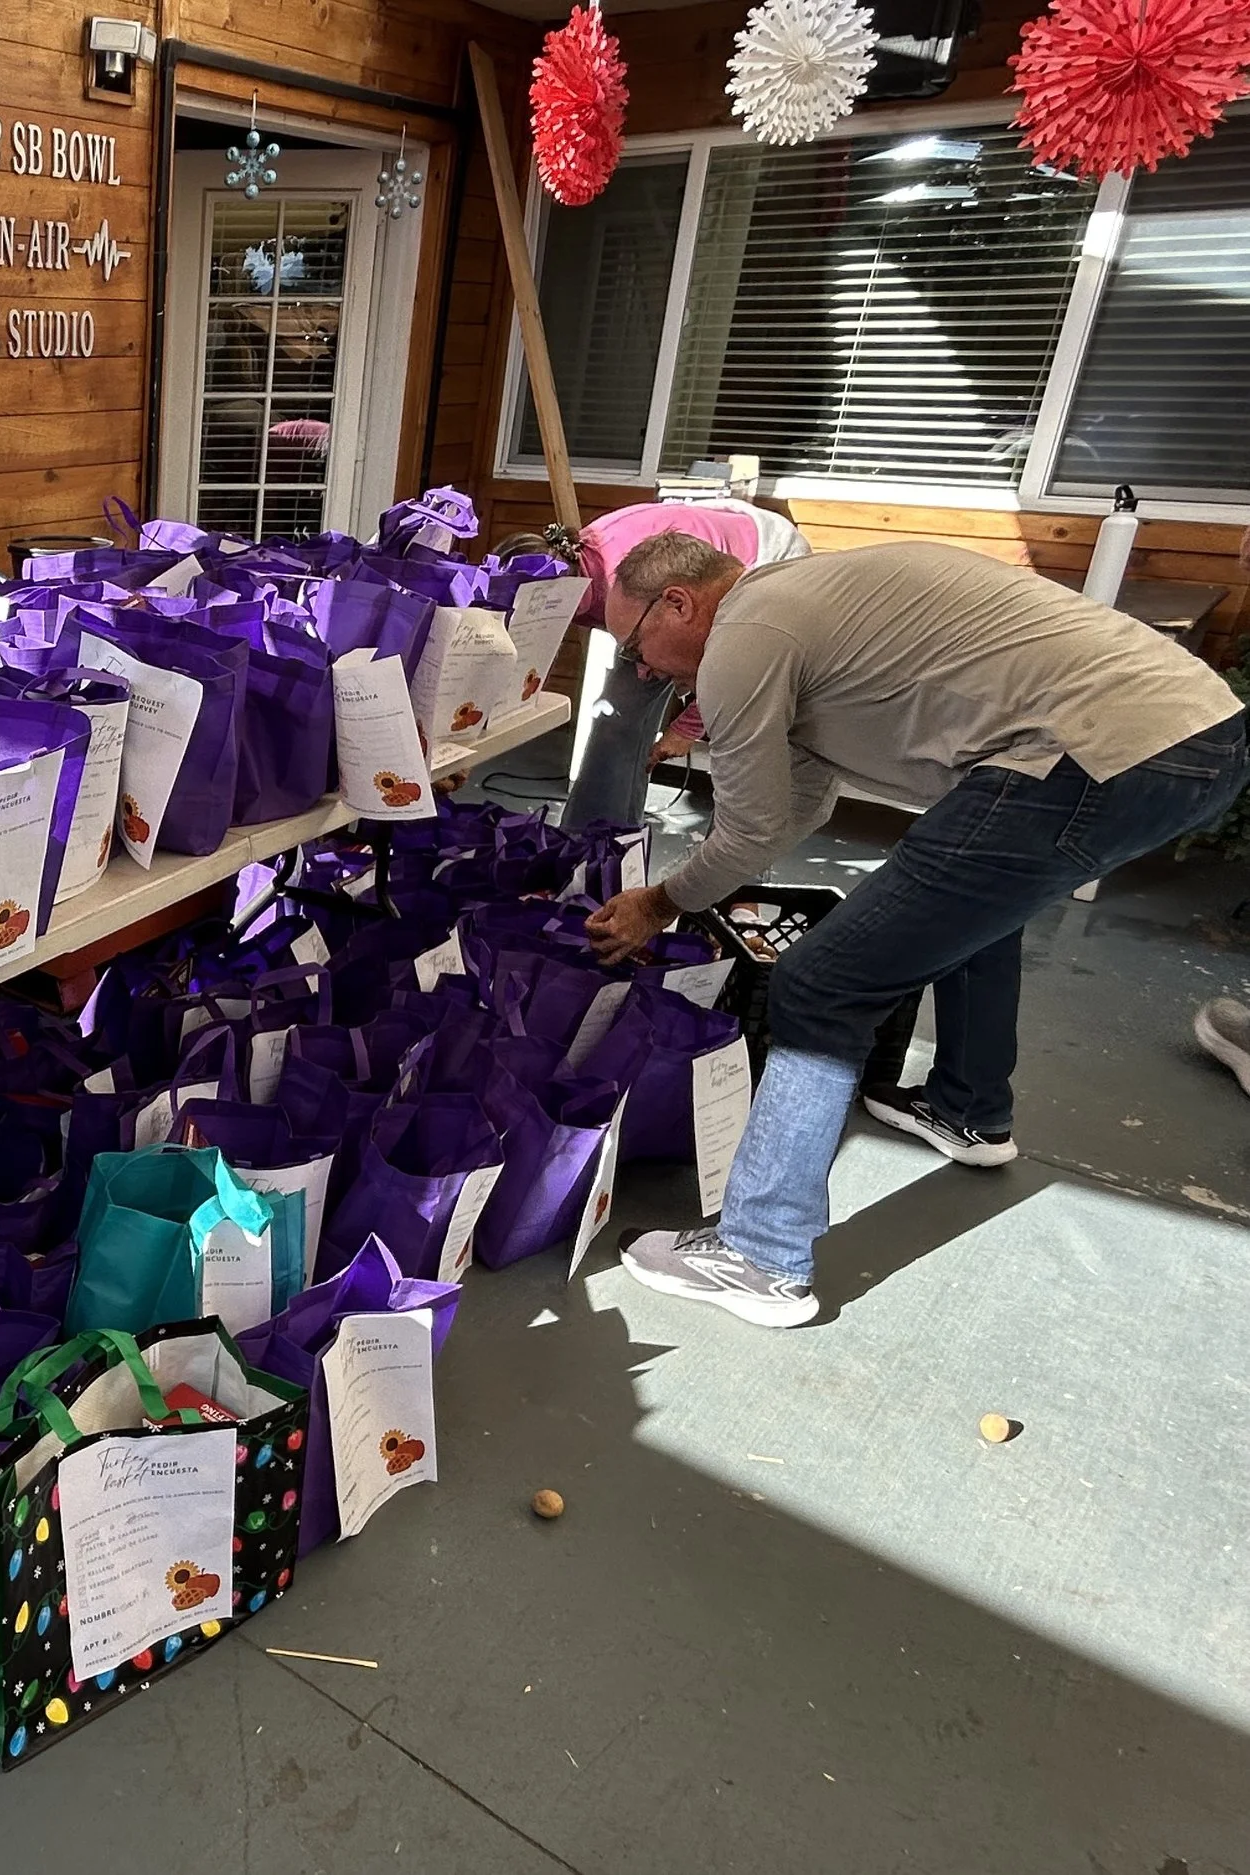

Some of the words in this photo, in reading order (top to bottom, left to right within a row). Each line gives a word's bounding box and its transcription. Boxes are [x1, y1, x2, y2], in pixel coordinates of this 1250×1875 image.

[12, 121, 43, 175] SB
[52, 127, 121, 186] BOWL
[8, 308, 95, 359] STUDIO
[131, 694, 165, 709] REQUEST
[357, 1344, 399, 1355] ENCUESTA
[97, 1446, 149, 1478] Turkey
[151, 1461, 178, 1469] PEDIR
[151, 1467, 199, 1476] ENCUESTA
[83, 1640, 100, 1652] APT
